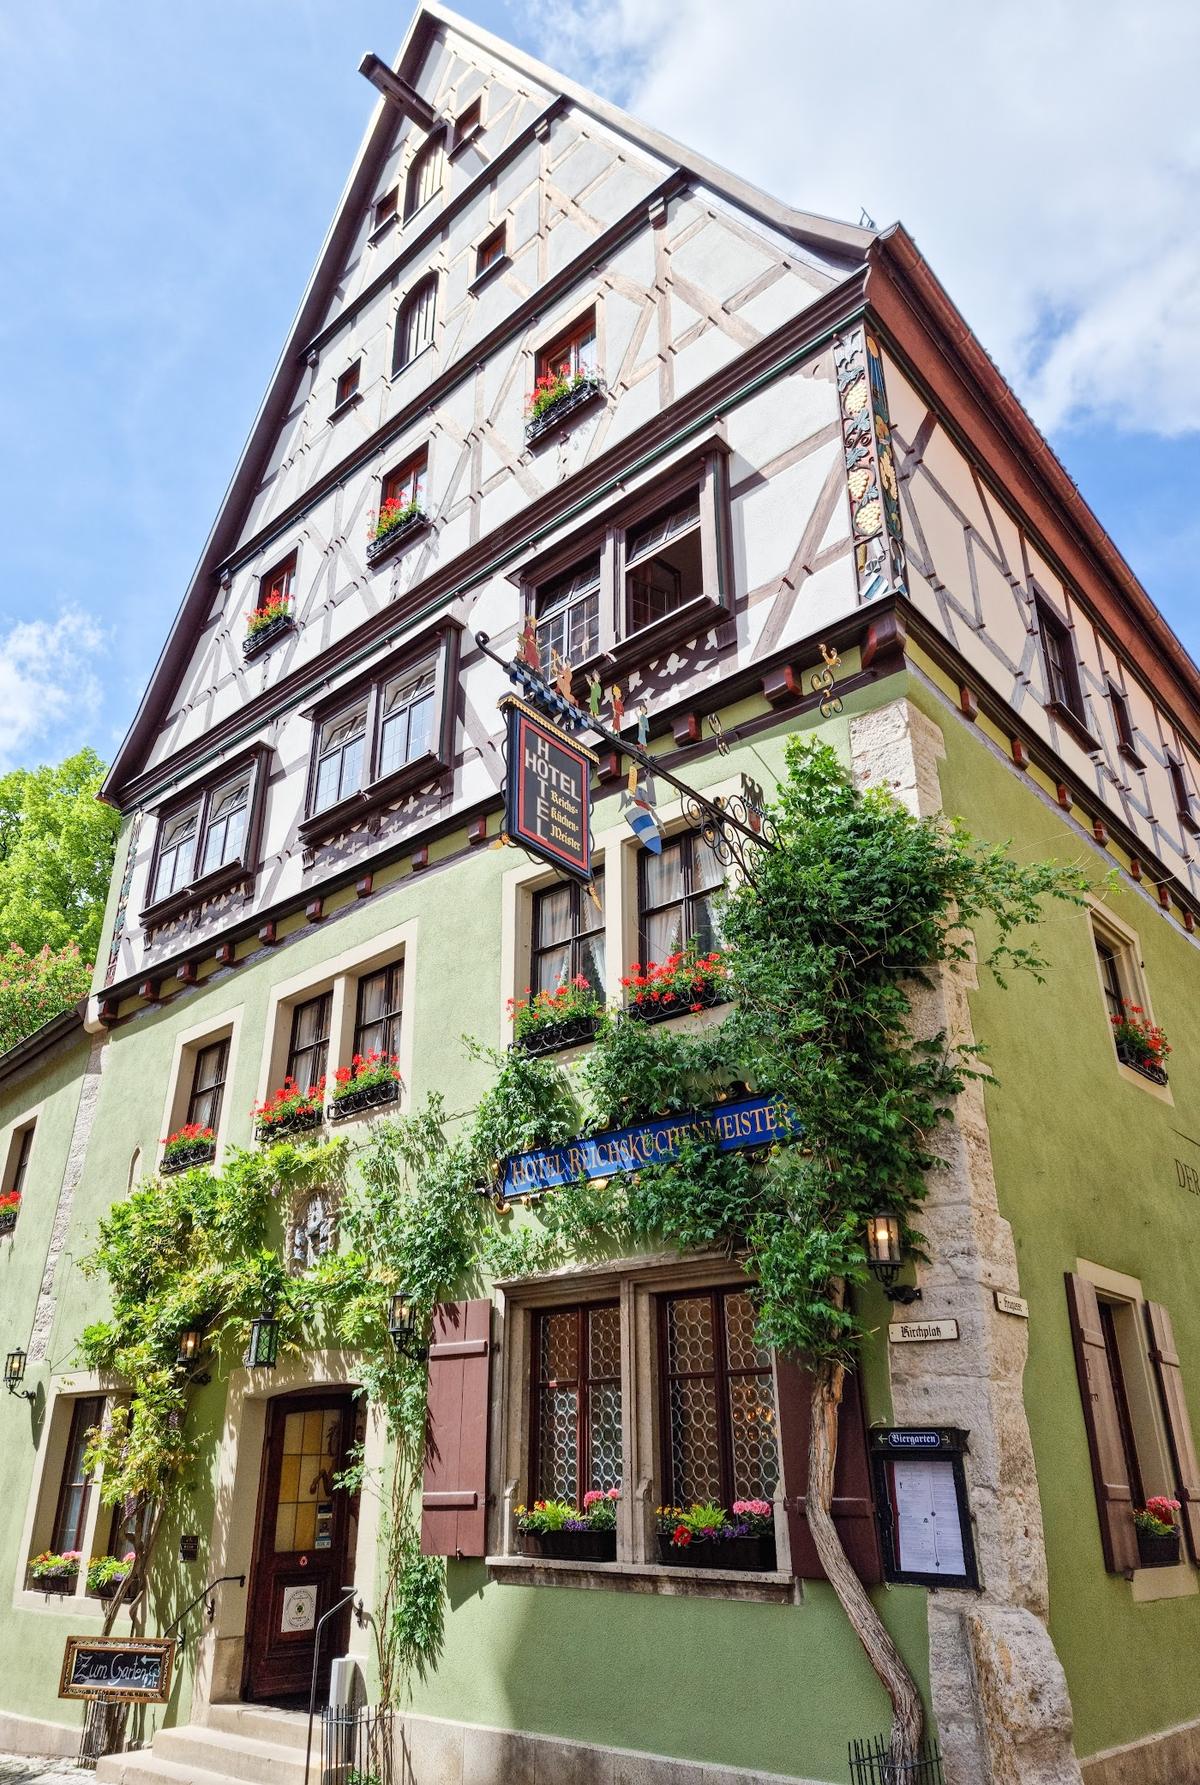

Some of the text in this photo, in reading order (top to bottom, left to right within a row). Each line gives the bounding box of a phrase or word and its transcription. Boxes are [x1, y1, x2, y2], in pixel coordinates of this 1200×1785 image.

[525, 748, 582, 802] HOTEL
[537, 736, 549, 842] HOTEL
[550, 823, 581, 851] Meister
[510, 1153, 566, 1188] HOTEL
[900, 1324, 942, 1339] Kirchplatz
[891, 1433, 936, 1446] Biergarten
[74, 1653, 148, 1686] Zum Garten
